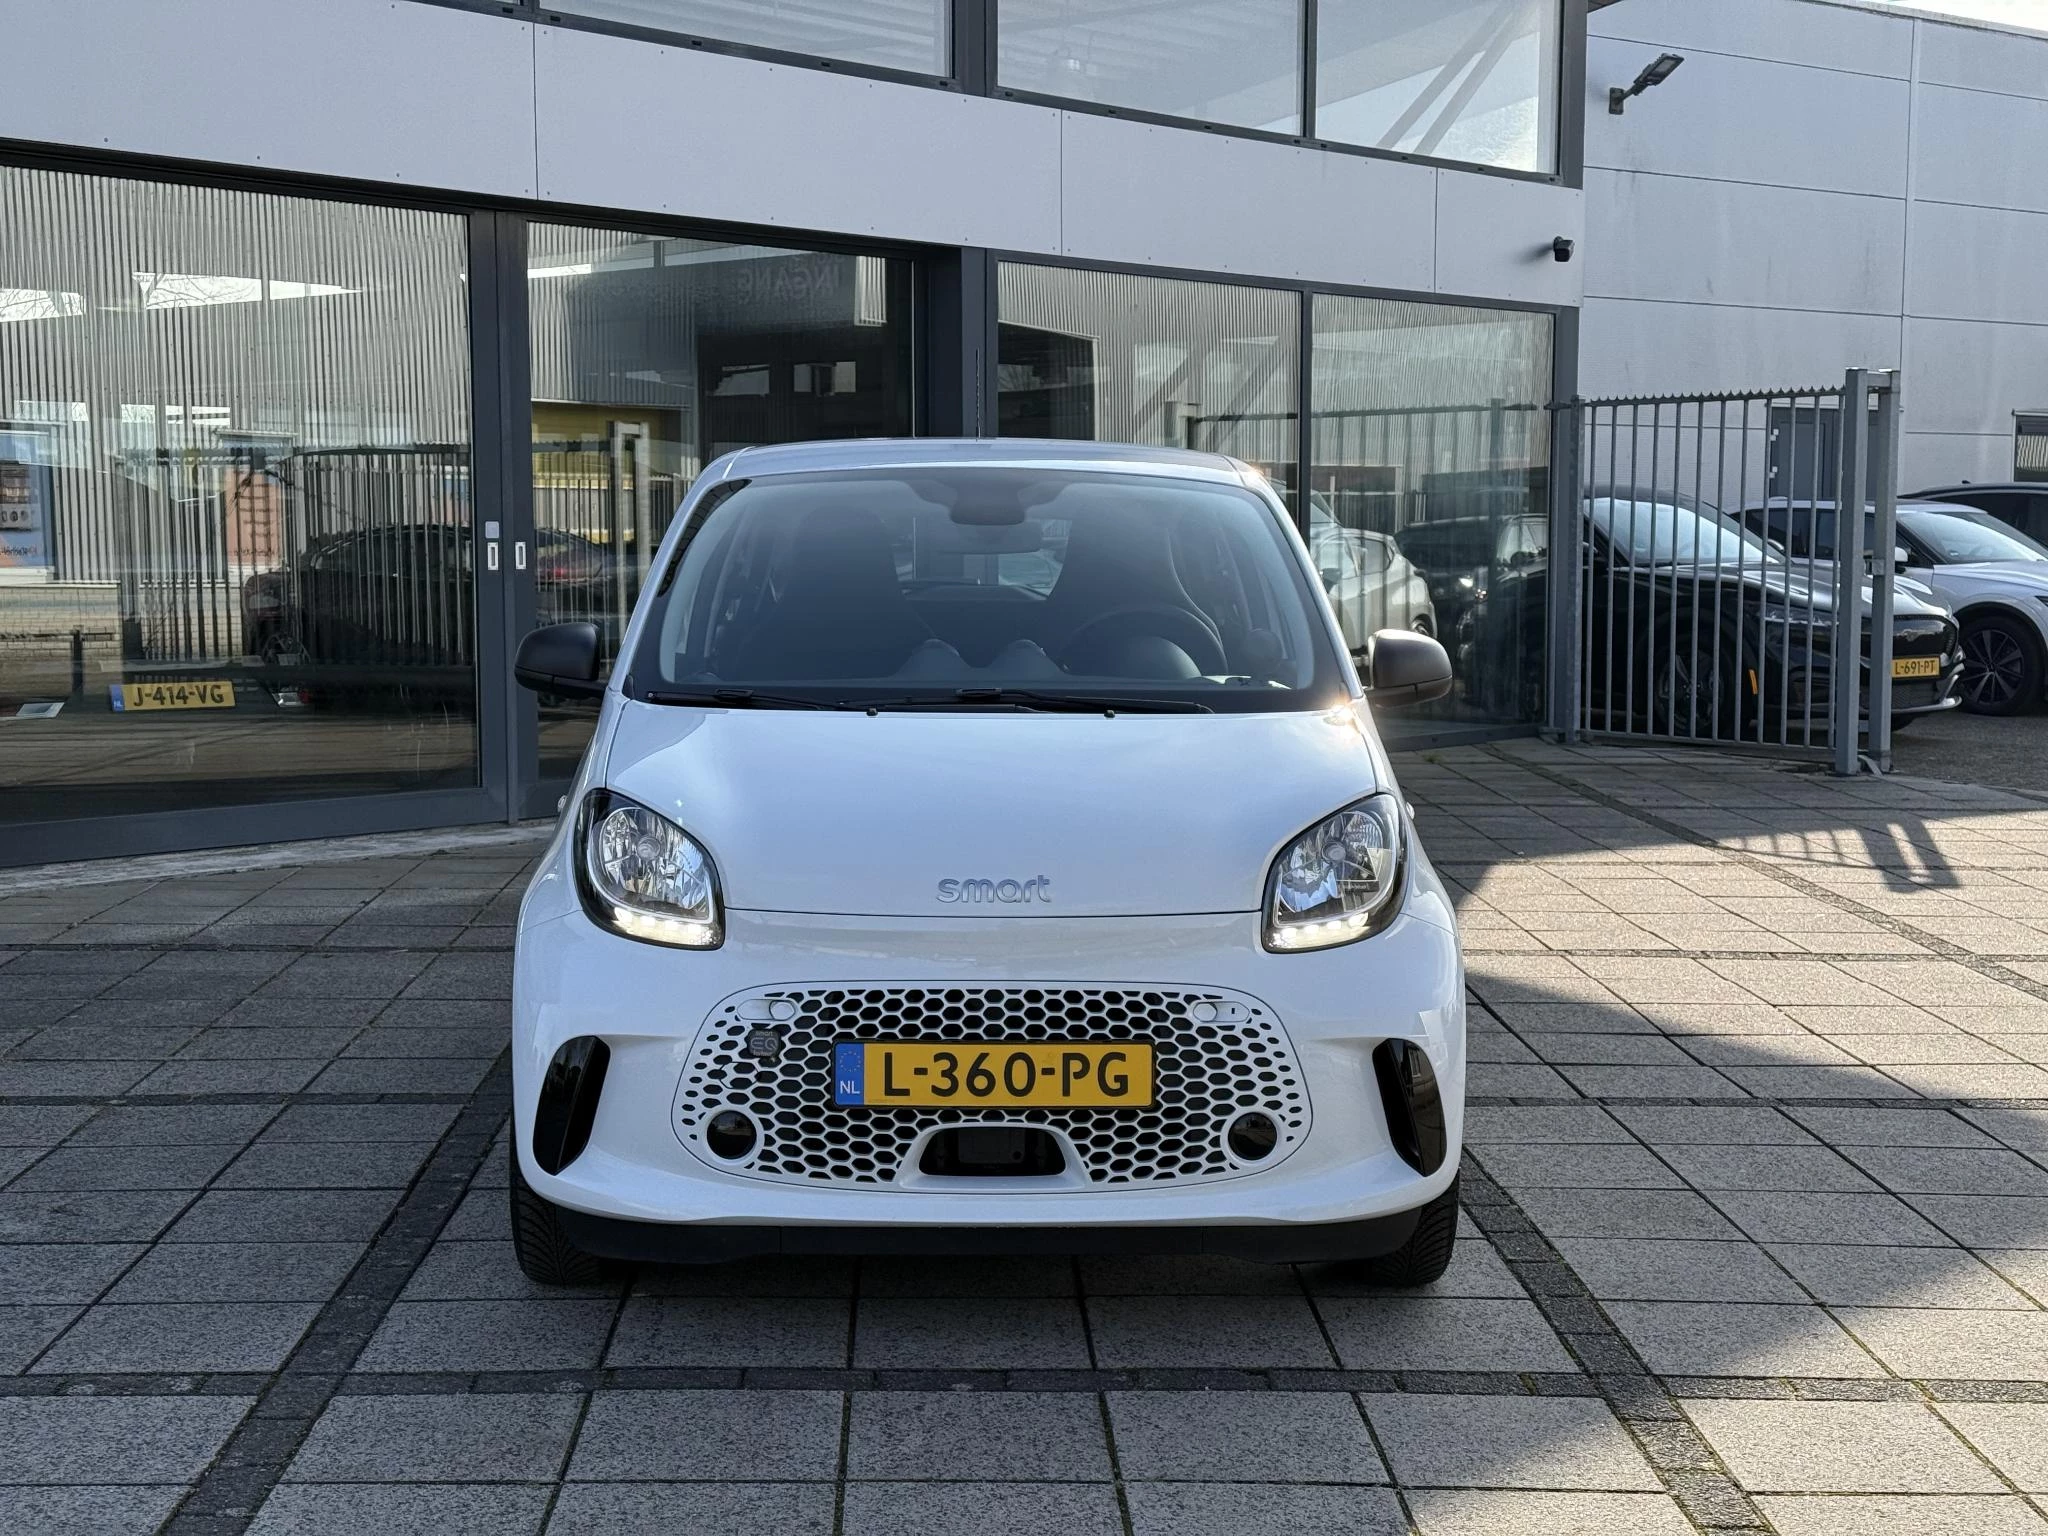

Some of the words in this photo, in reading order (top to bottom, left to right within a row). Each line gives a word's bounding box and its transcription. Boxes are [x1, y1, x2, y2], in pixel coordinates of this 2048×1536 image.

[1894, 660, 1935, 675] L-691-PT
[133, 684, 225, 707] J-414-VG
[936, 874, 1051, 904] smart
[884, 1051, 1129, 1098] L-360-PG
[839, 1080, 861, 1095] NL
